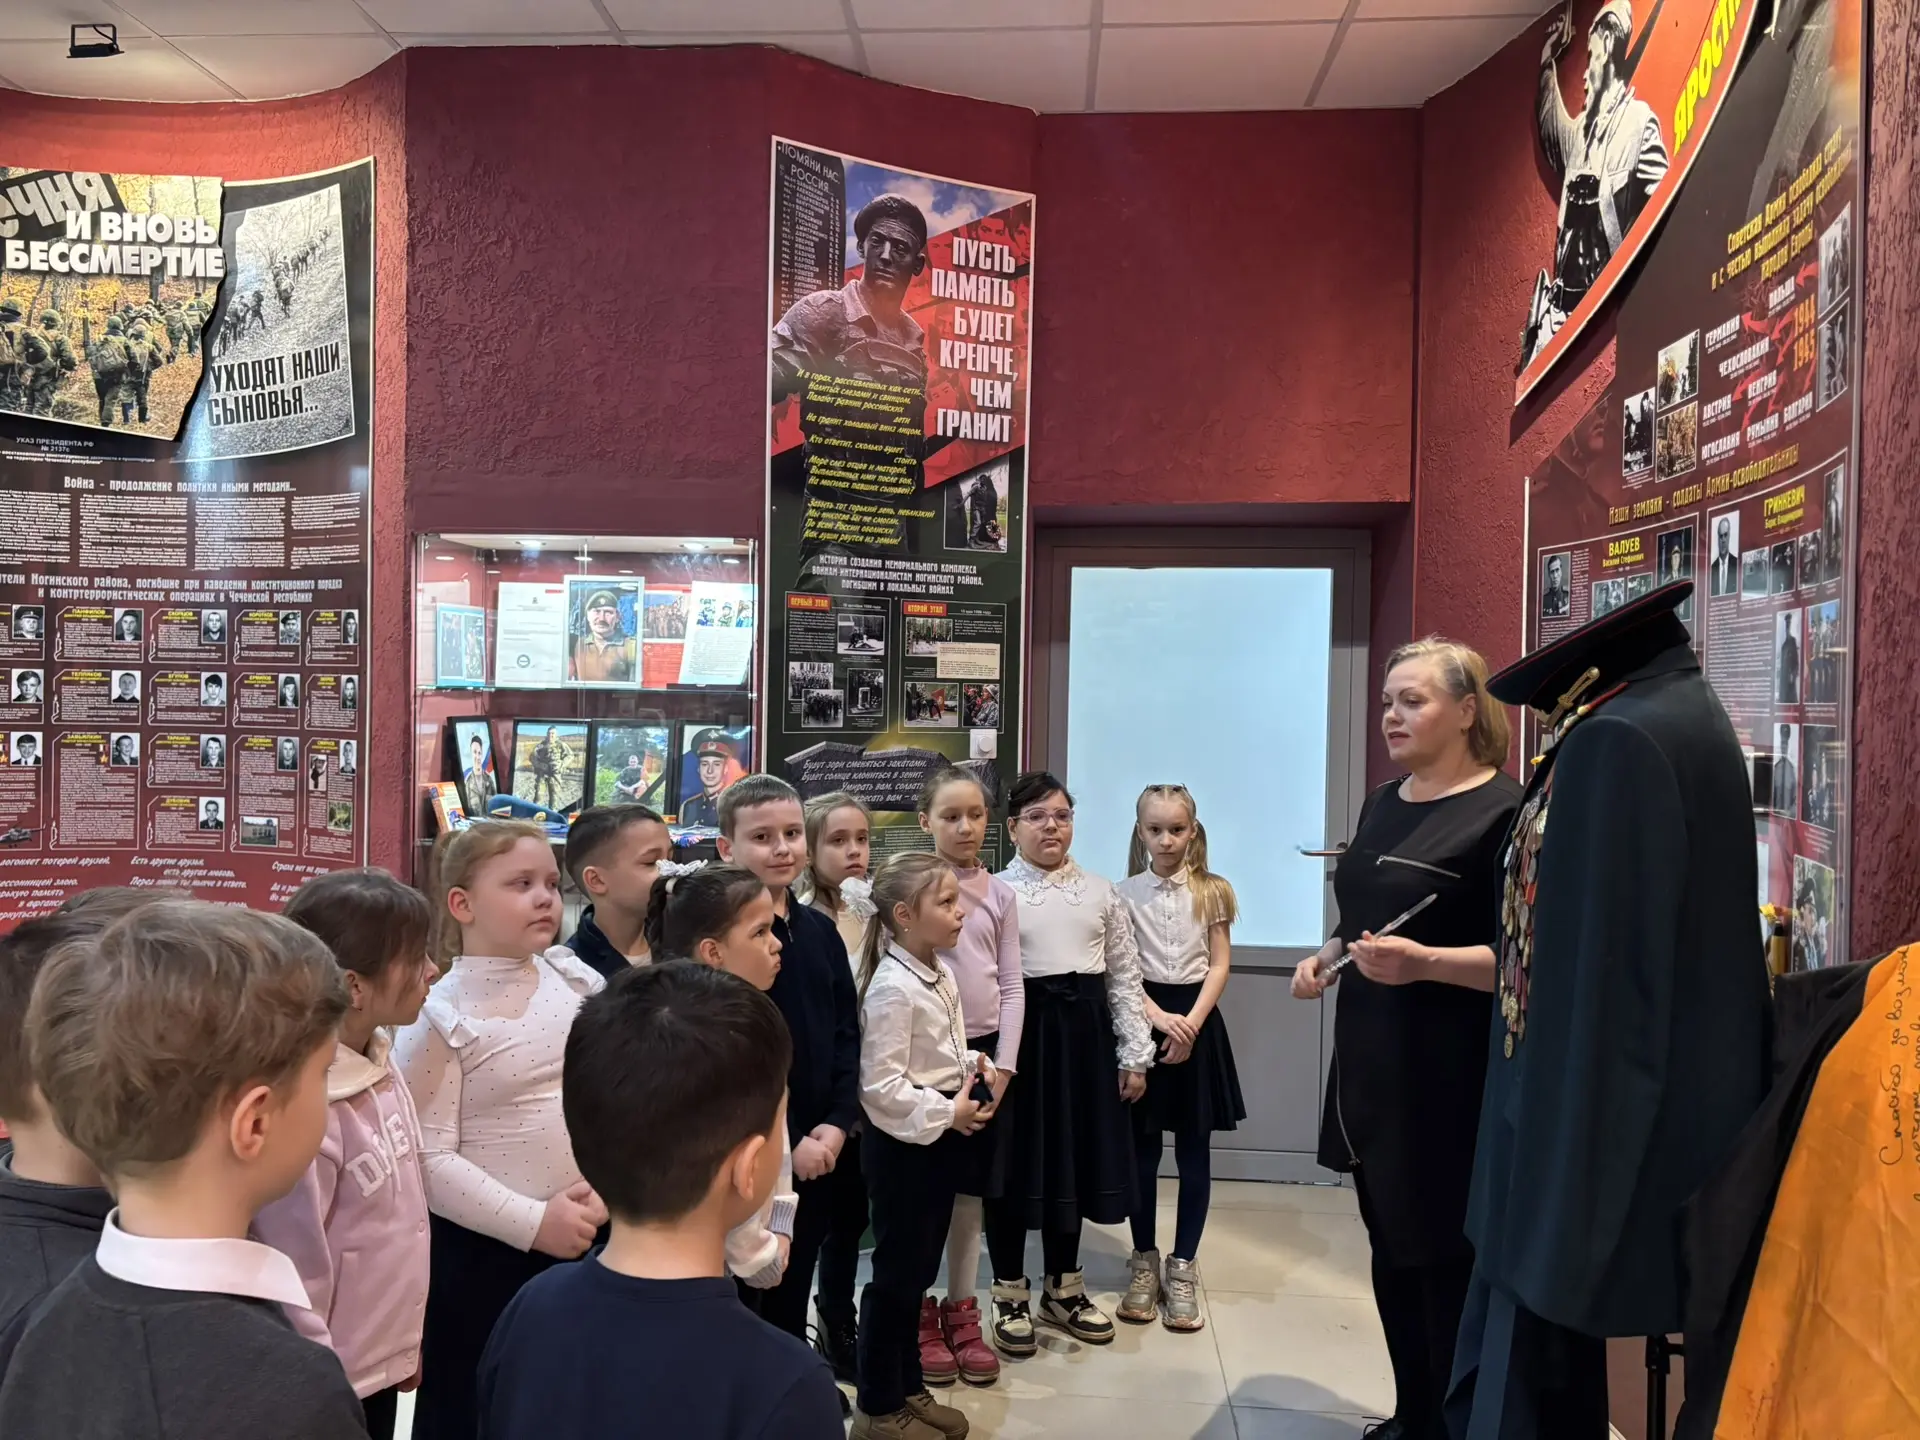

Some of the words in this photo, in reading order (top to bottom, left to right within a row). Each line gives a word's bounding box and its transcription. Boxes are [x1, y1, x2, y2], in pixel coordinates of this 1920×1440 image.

[782, 142, 821, 173] ПОМЯНИ
[66, 210, 91, 239] И
[100, 211, 219, 244] ВНОВЬ
[5, 238, 225, 278] БЕССМЕРТИЕ
[952, 236, 1016, 273] ПУСТЬ
[931, 267, 1014, 308] ПАМЯТЬ
[954, 306, 1014, 343] БУДЕТ
[1705, 314, 1740, 348] ГЕРМАНИЯ
[1719, 336, 1769, 377] ЧЕХОСЛОВАКИЯ
[1794, 328, 1815, 371] 1945
[211, 354, 287, 394] УХОДЯТ
[292, 343, 341, 382] НАШИ
[940, 338, 1018, 381] КРЕПЧЕ,
[808, 382, 840, 394] Налитых
[841, 388, 871, 399] слезами
[833, 377, 888, 391] расставленных
[889, 384, 901, 394] как
[970, 377, 1012, 409] ЧЕМ
[1748, 370, 1777, 399] ВЕНГРИЯ
[207, 388, 319, 427] СЫНОВЬЯ...
[861, 402, 905, 413] российских
[1703, 394, 1732, 421] АВСТРИЯ
[806, 412, 816, 422] На
[817, 416, 842, 427] гранит
[843, 419, 878, 431] холодный
[936, 407, 1012, 443] ГРАНИТ
[1747, 413, 1779, 442] РУМЫНИЯ
[36, 438, 82, 446] ПРЕЗИДЕНТА
[809, 434, 823, 444] Кто
[855, 443, 883, 453] сколько
[1701, 431, 1740, 460] ЮГОСЛАВИЯ
[64, 476, 95, 489] Война
[110, 480, 172, 493] продолжение
[177, 481, 217, 494] политики
[221, 481, 249, 493] иными
[808, 476, 820, 486] На
[1609, 505, 1630, 525] Наши
[1633, 496, 1663, 519] земляки
[1673, 483, 1703, 509] солдаты
[833, 522, 860, 532] России
[861, 526, 894, 535] обелиски
[1608, 536, 1640, 557] ВАЛУЕВ
[819, 554, 848, 567] ИСТОРИЯ
[851, 557, 882, 569] СОЗДАНИЯ
[885, 560, 938, 572] МЕМОРИАЛЬНОГО
[941, 563, 977, 574] КОМПЛЕКСА
[1602, 557, 1620, 568] Василий
[1620, 553, 1644, 566] Стефанович
[31, 573, 88, 587] Ногинского
[95, 576, 131, 590] района,
[136, 577, 180, 590] погибшие
[184, 579, 200, 592] при
[204, 579, 247, 590] наведении
[251, 578, 315, 591] конституционного
[842, 579, 877, 591] ПОГИБШИМ
[887, 581, 925, 593] ЛОКАЛЬНЫХ
[928, 583, 954, 595] ВОЙНАХ
[915, 571, 954, 584] НОГИНСКОГО
[38, 588, 44, 599] и
[50, 588, 165, 602] контртеррористических
[170, 591, 216, 604] операциях
[229, 592, 269, 603] Чеченской
[273, 592, 313, 605] республике
[791, 597, 812, 607] ПЕРВЫЙ
[815, 599, 828, 608] ЭТАП
[908, 603, 928, 613] ВТОРОЙ
[930, 605, 943, 614] ЭТАП
[803, 759, 825, 771] Будут
[826, 761, 845, 771] зори
[846, 760, 887, 770] сменяться
[801, 771, 823, 782] Будет
[824, 772, 851, 782] солнце
[851, 771, 890, 780] клониться
[841, 782, 874, 793] Умирать
[886, 794, 902, 802] вам
[131, 856, 148, 865] Есть
[149, 857, 177, 868] другие
[163, 869, 180, 877] есть
[1878, 1063, 1905, 1166] Спасибо
